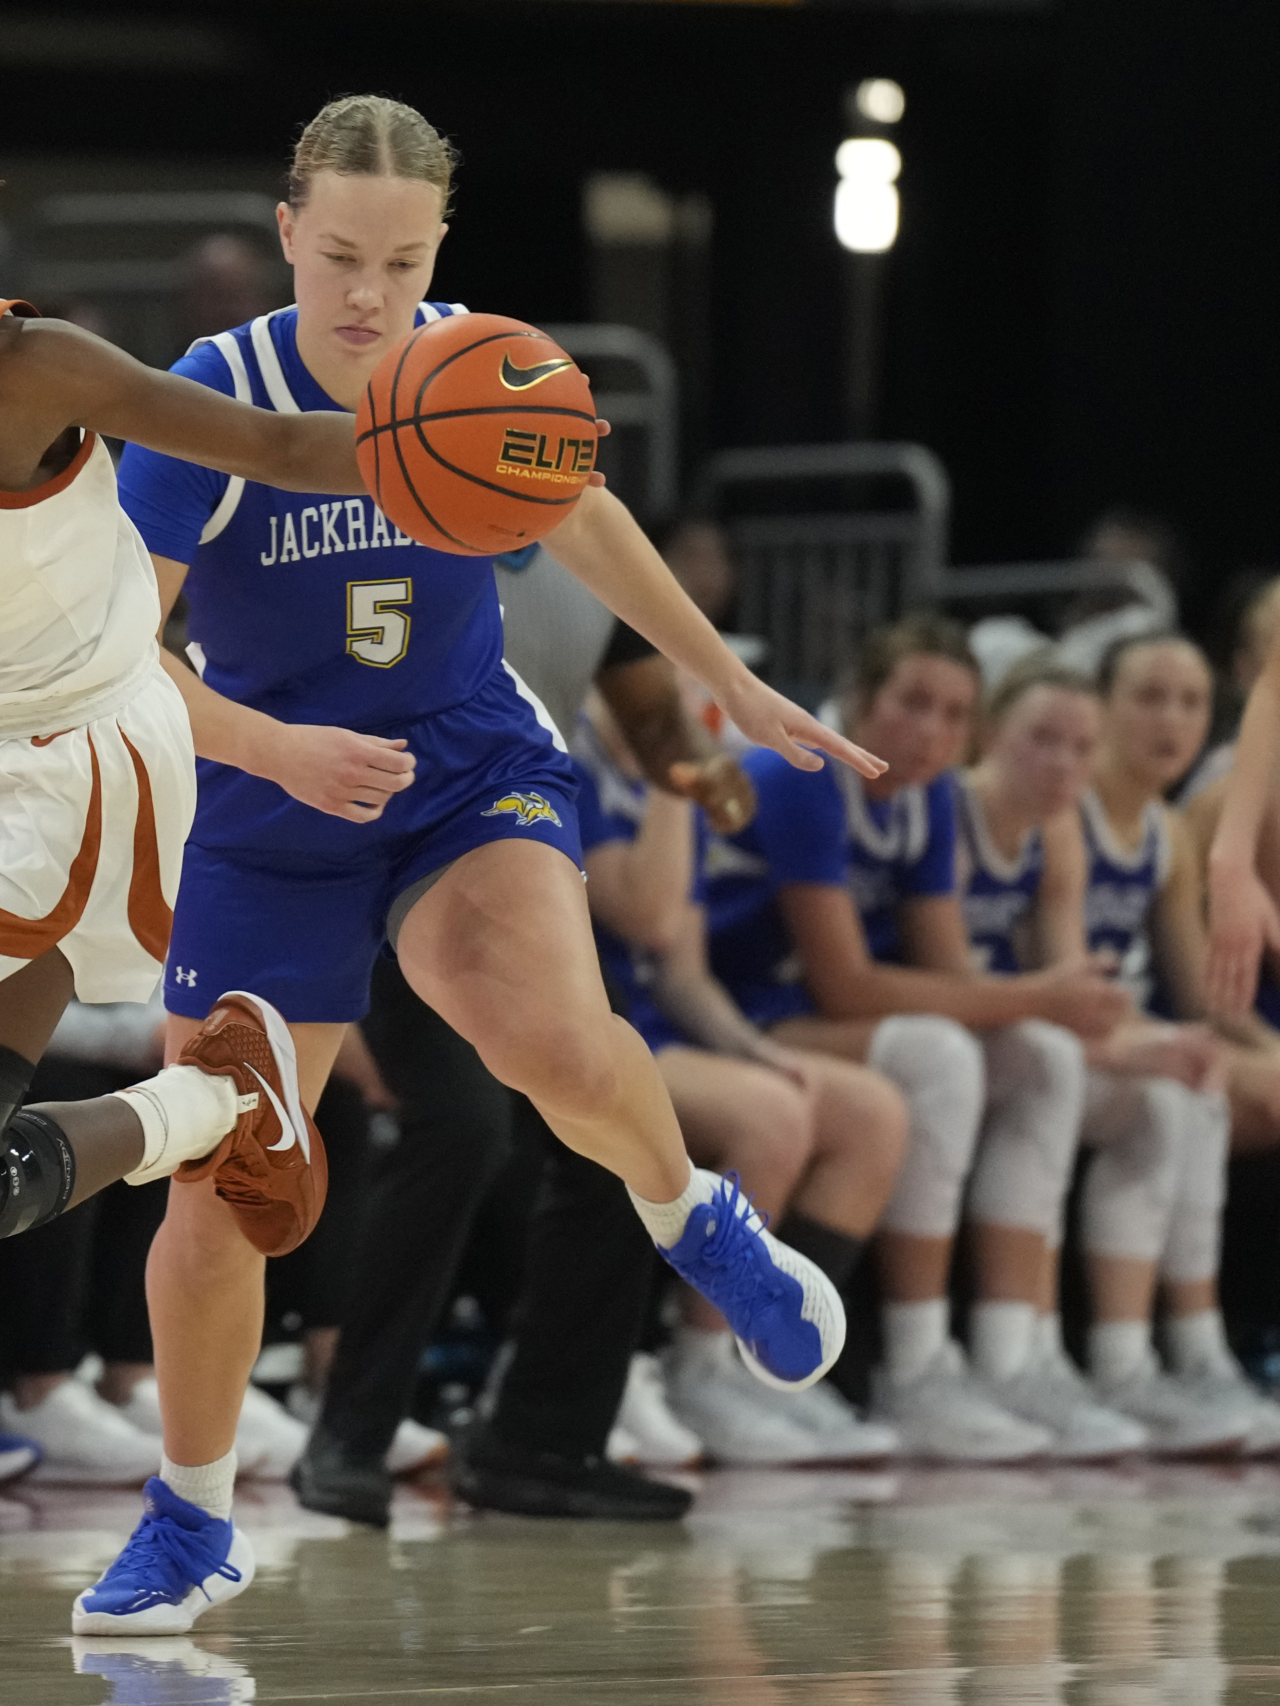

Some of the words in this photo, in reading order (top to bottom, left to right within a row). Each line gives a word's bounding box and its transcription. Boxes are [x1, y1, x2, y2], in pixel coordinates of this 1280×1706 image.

[499, 427, 595, 474] ELITE
[260, 498, 426, 566] JACKRA
[345, 577, 412, 669] 5
